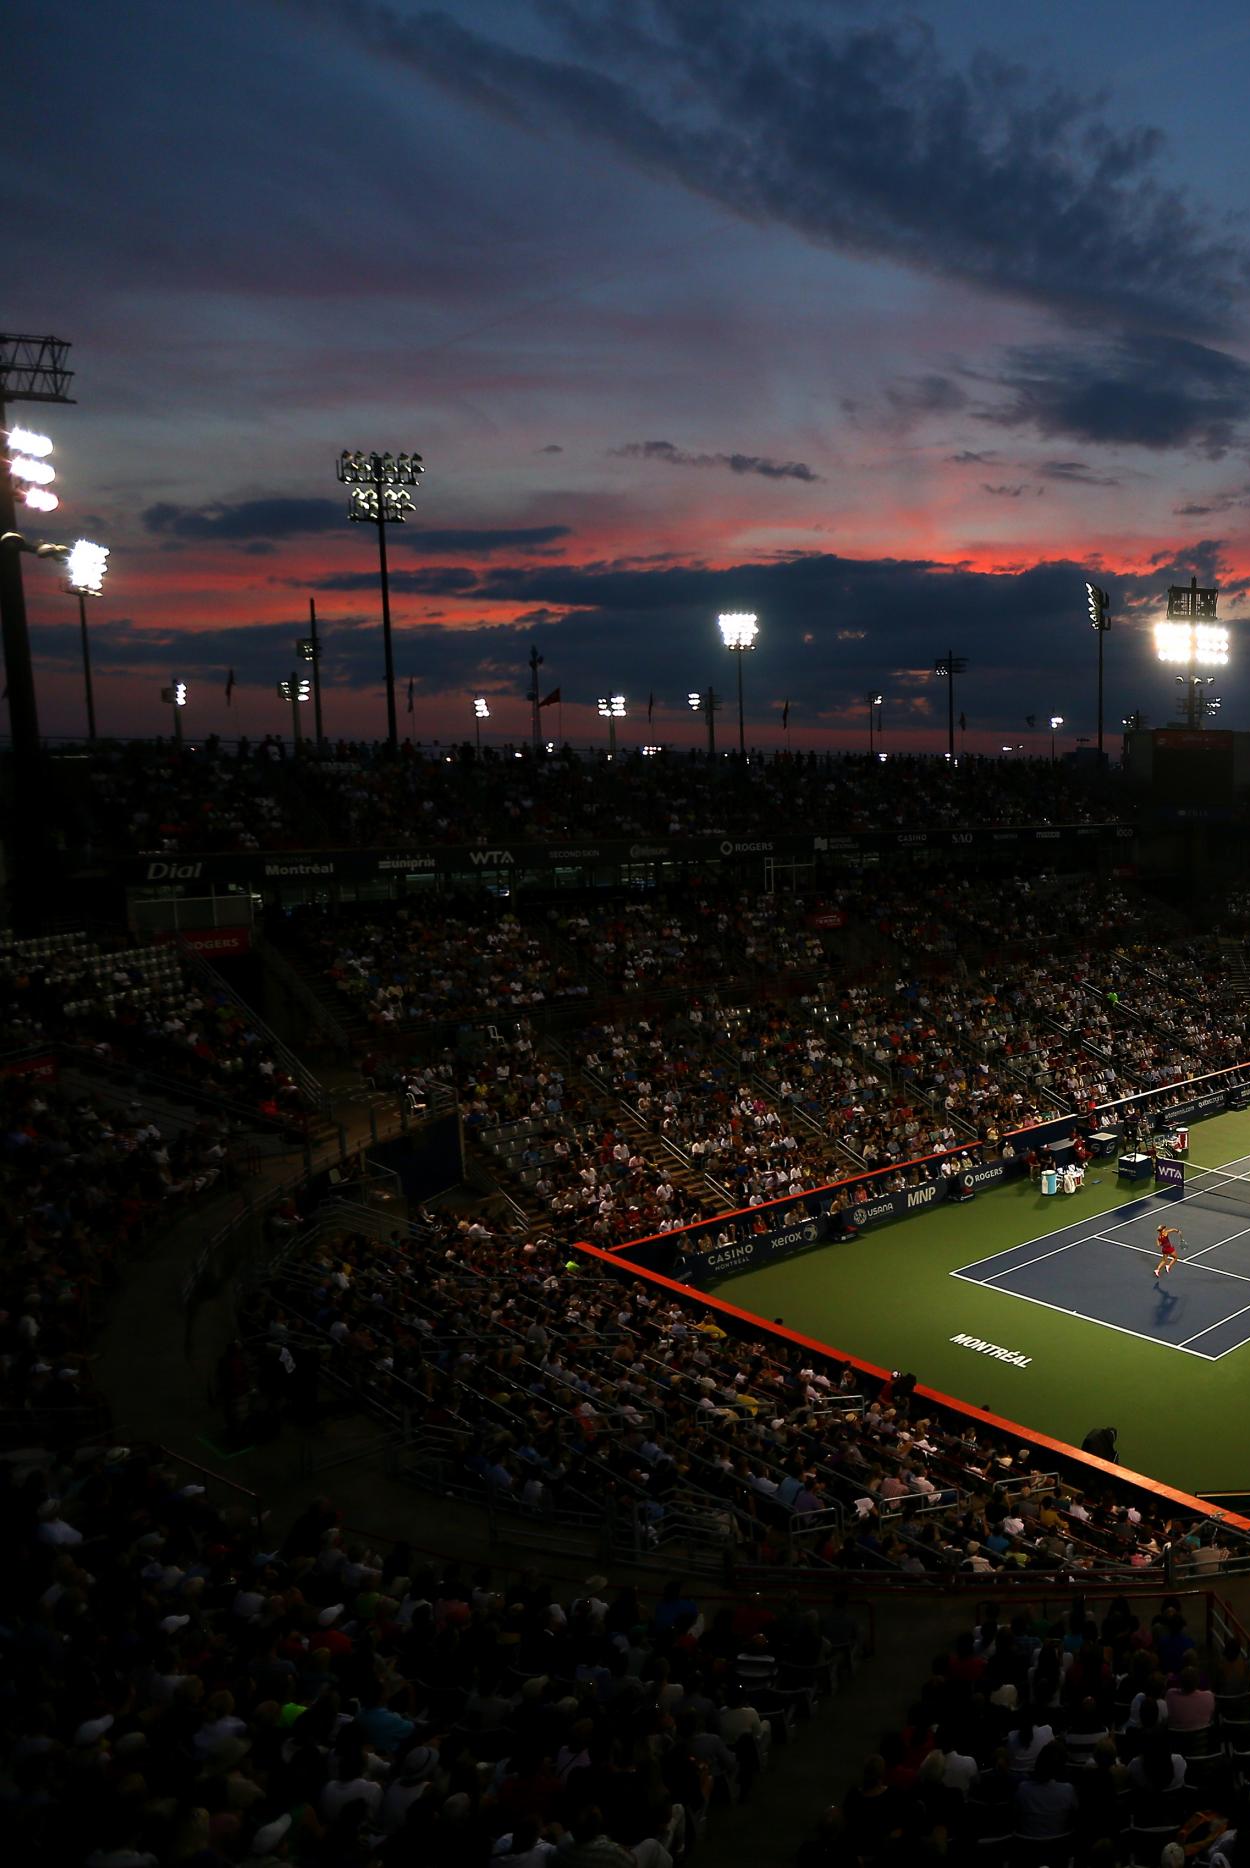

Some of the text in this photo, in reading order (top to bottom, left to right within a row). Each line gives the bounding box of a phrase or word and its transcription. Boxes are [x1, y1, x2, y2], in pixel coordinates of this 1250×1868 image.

[897, 833, 927, 842] CASINO
[952, 833, 973, 844] SAQ
[735, 842, 774, 852] ROGERS
[469, 851, 514, 865] WTA
[146, 862, 203, 881] Dial
[265, 862, 334, 876] Montréal
[975, 1167, 1004, 1182] ROGERS
[1158, 1165, 1182, 1179] WTA
[907, 1186, 936, 1207] MNP
[868, 1203, 894, 1217] USANA
[771, 1231, 802, 1248] xerox
[708, 1244, 753, 1265] CASINO
[949, 1332, 1032, 1368] MONTRÉAL
